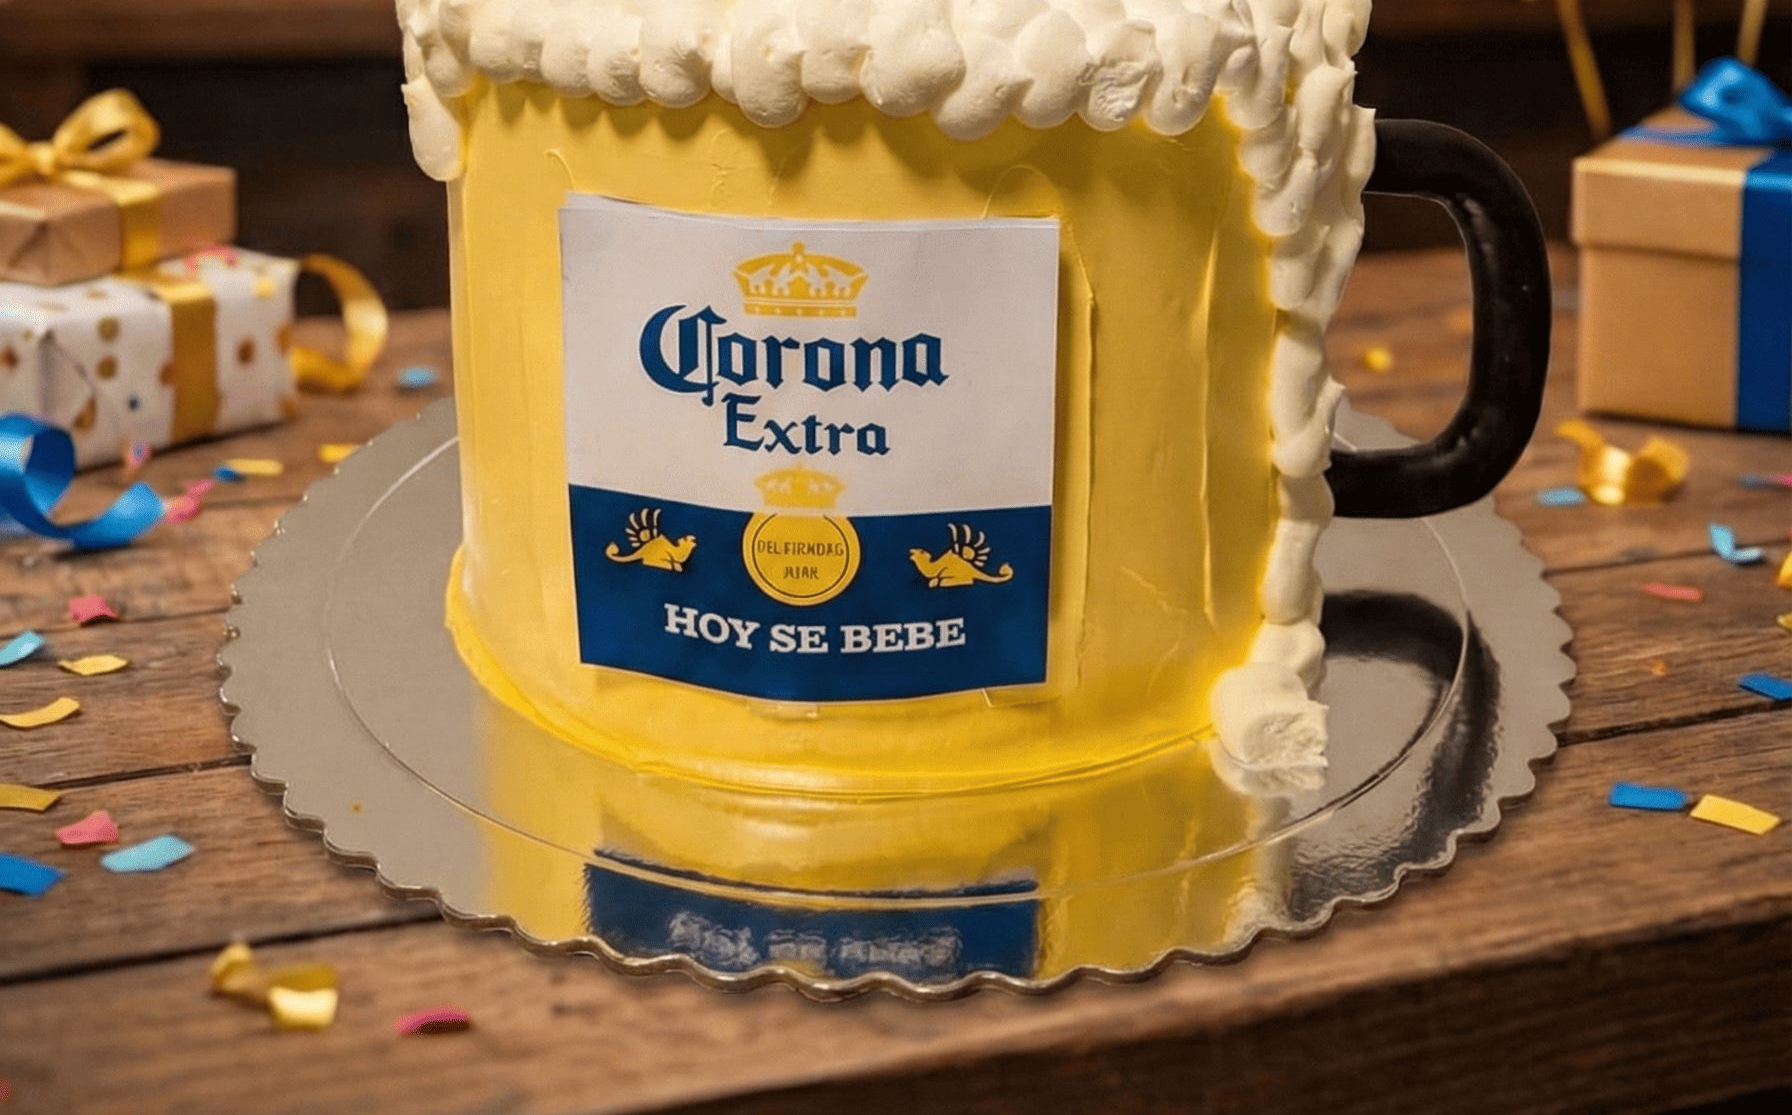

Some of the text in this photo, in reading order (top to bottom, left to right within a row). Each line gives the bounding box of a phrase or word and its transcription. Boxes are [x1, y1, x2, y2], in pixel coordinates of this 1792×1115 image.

[639, 304, 950, 407] Corona
[721, 392, 891, 456] Extra
[664, 603, 966, 653] HOY SE BEBE
